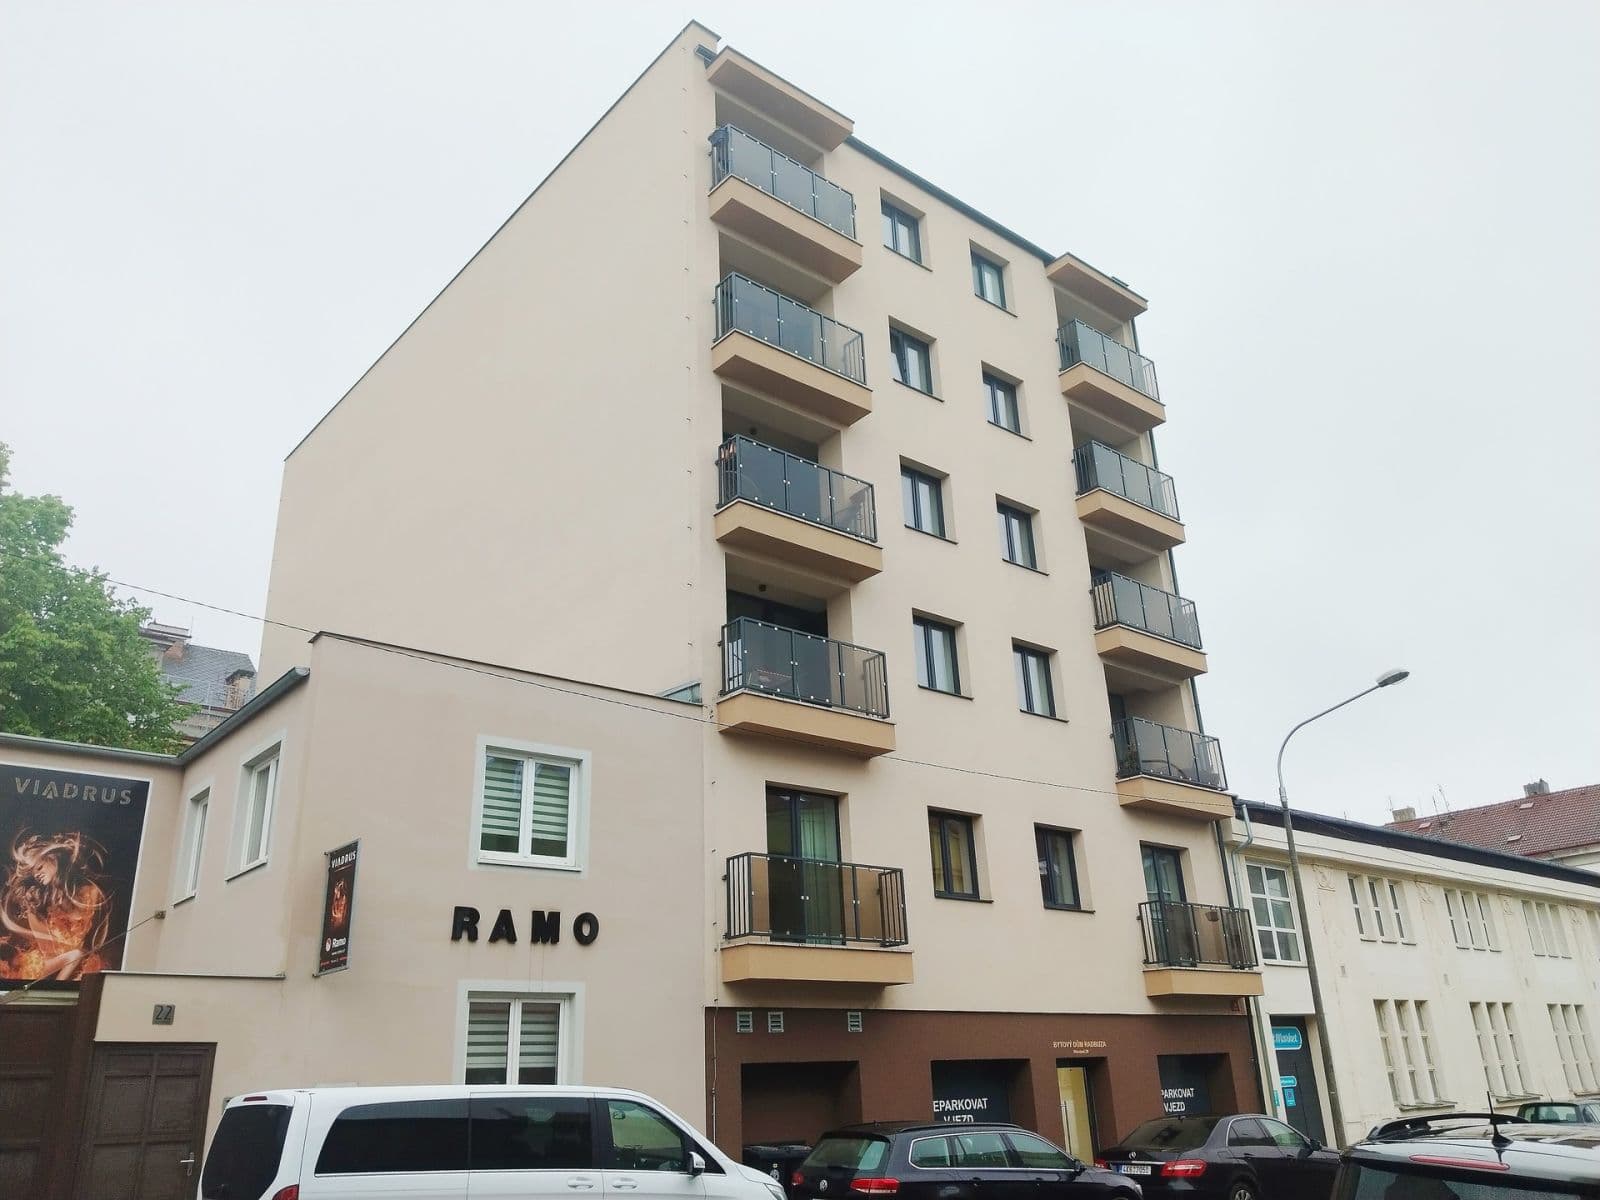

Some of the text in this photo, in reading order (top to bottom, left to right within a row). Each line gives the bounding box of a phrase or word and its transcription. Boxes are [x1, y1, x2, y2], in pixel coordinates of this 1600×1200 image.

[15, 776, 134, 805] VIADRUS
[451, 905, 600, 946] RAMO
[155, 1004, 172, 1020] 22
[1163, 1101, 1186, 1112] VJEZD
